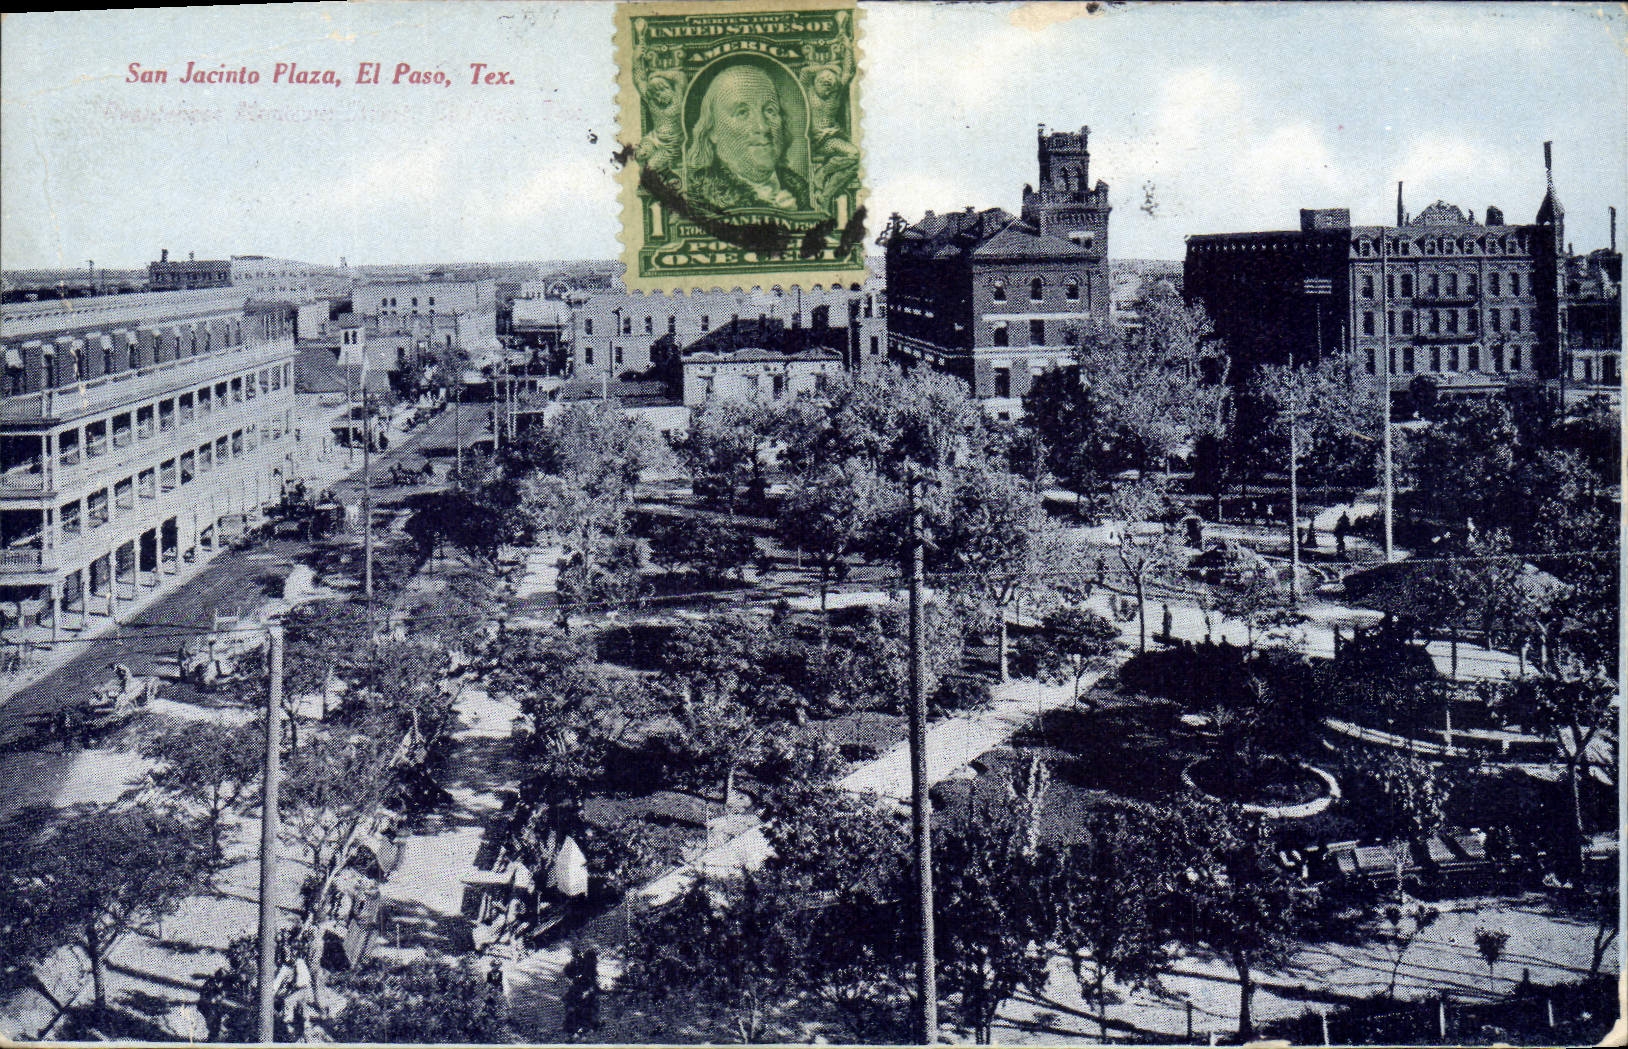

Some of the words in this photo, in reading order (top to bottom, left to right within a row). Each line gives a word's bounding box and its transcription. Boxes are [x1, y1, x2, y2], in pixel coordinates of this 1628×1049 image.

[752, 14, 790, 23] 1902
[648, 25, 724, 38] UNITED
[726, 22, 804, 35] STATES
[806, 21, 835, 32] OF
[687, 41, 800, 62] AMERICA
[649, 200, 664, 237] 1
[836, 194, 848, 231] 1
[714, 215, 792, 231] ANKLIN
[661, 252, 738, 266] ONE
